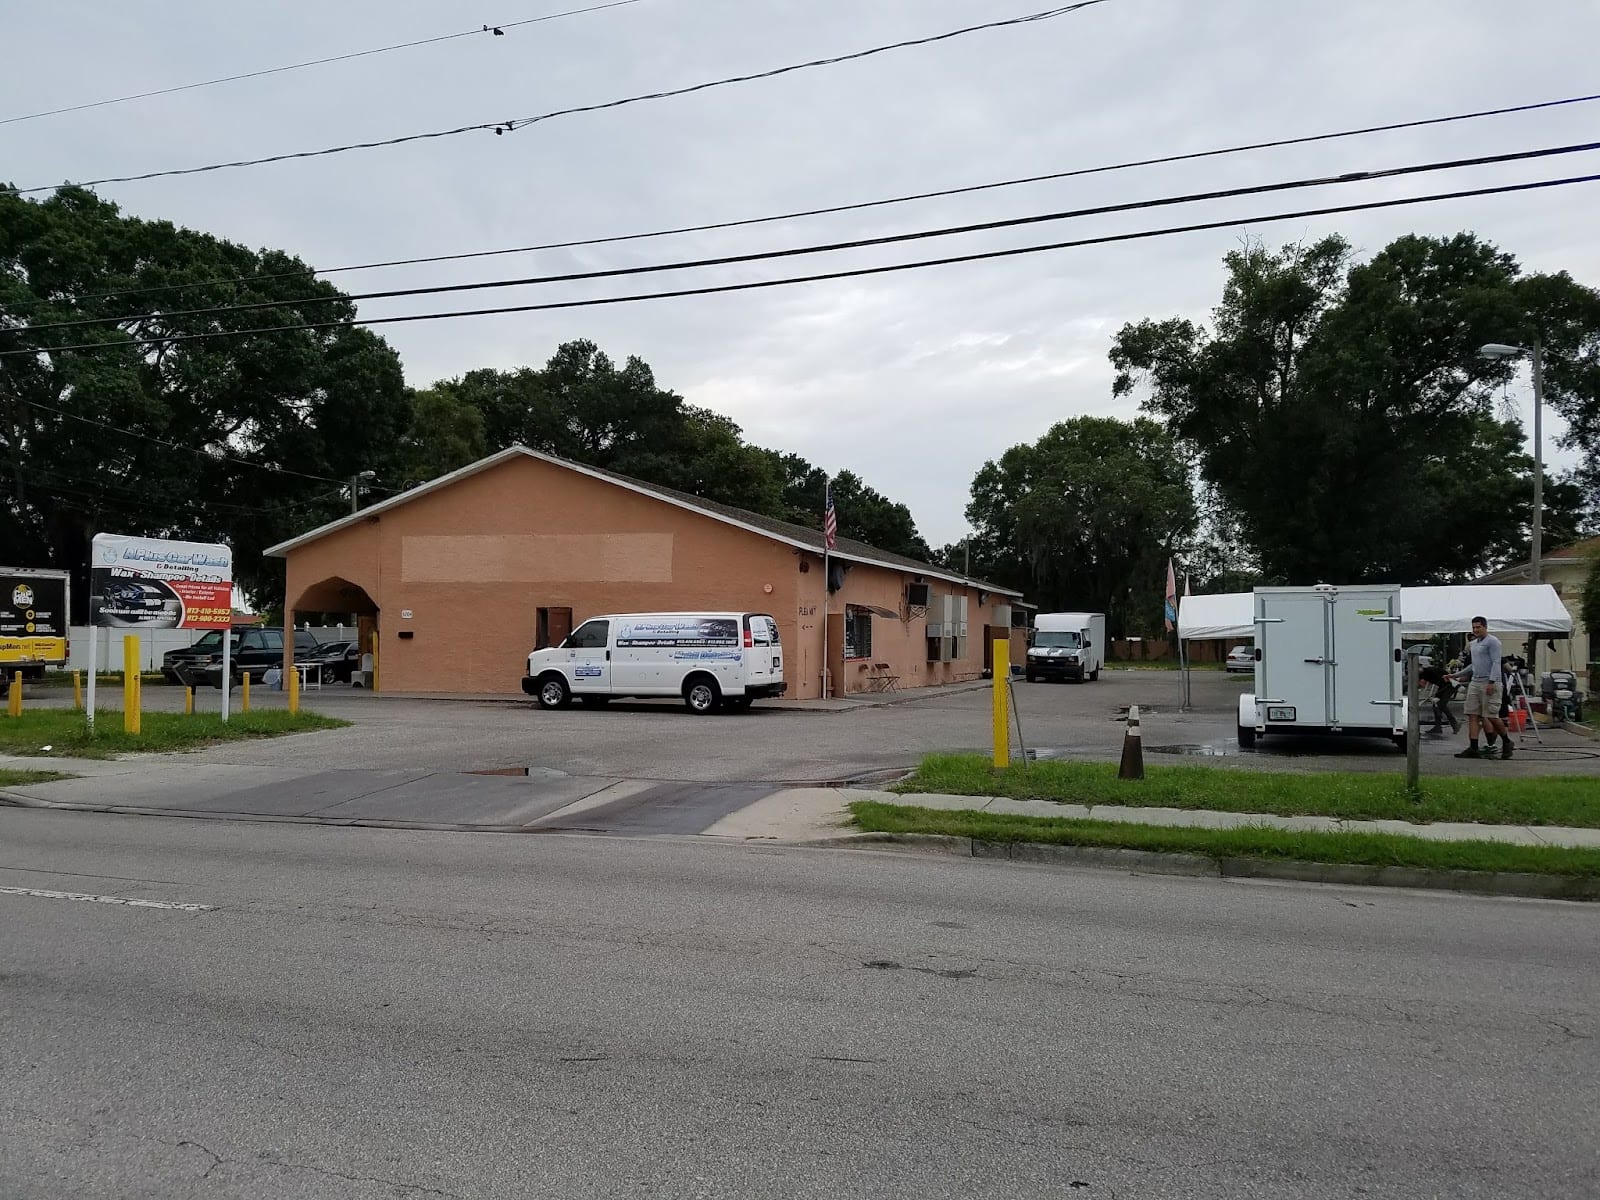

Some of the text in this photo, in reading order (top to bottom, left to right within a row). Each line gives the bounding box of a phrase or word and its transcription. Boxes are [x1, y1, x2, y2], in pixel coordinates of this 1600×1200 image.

[136, 549, 166, 562] Plus
[166, 551, 192, 564] Car
[192, 553, 229, 567] Wash
[110, 567, 223, 584] Wax Shampoo Details
[163, 563, 199, 572] Detailing
